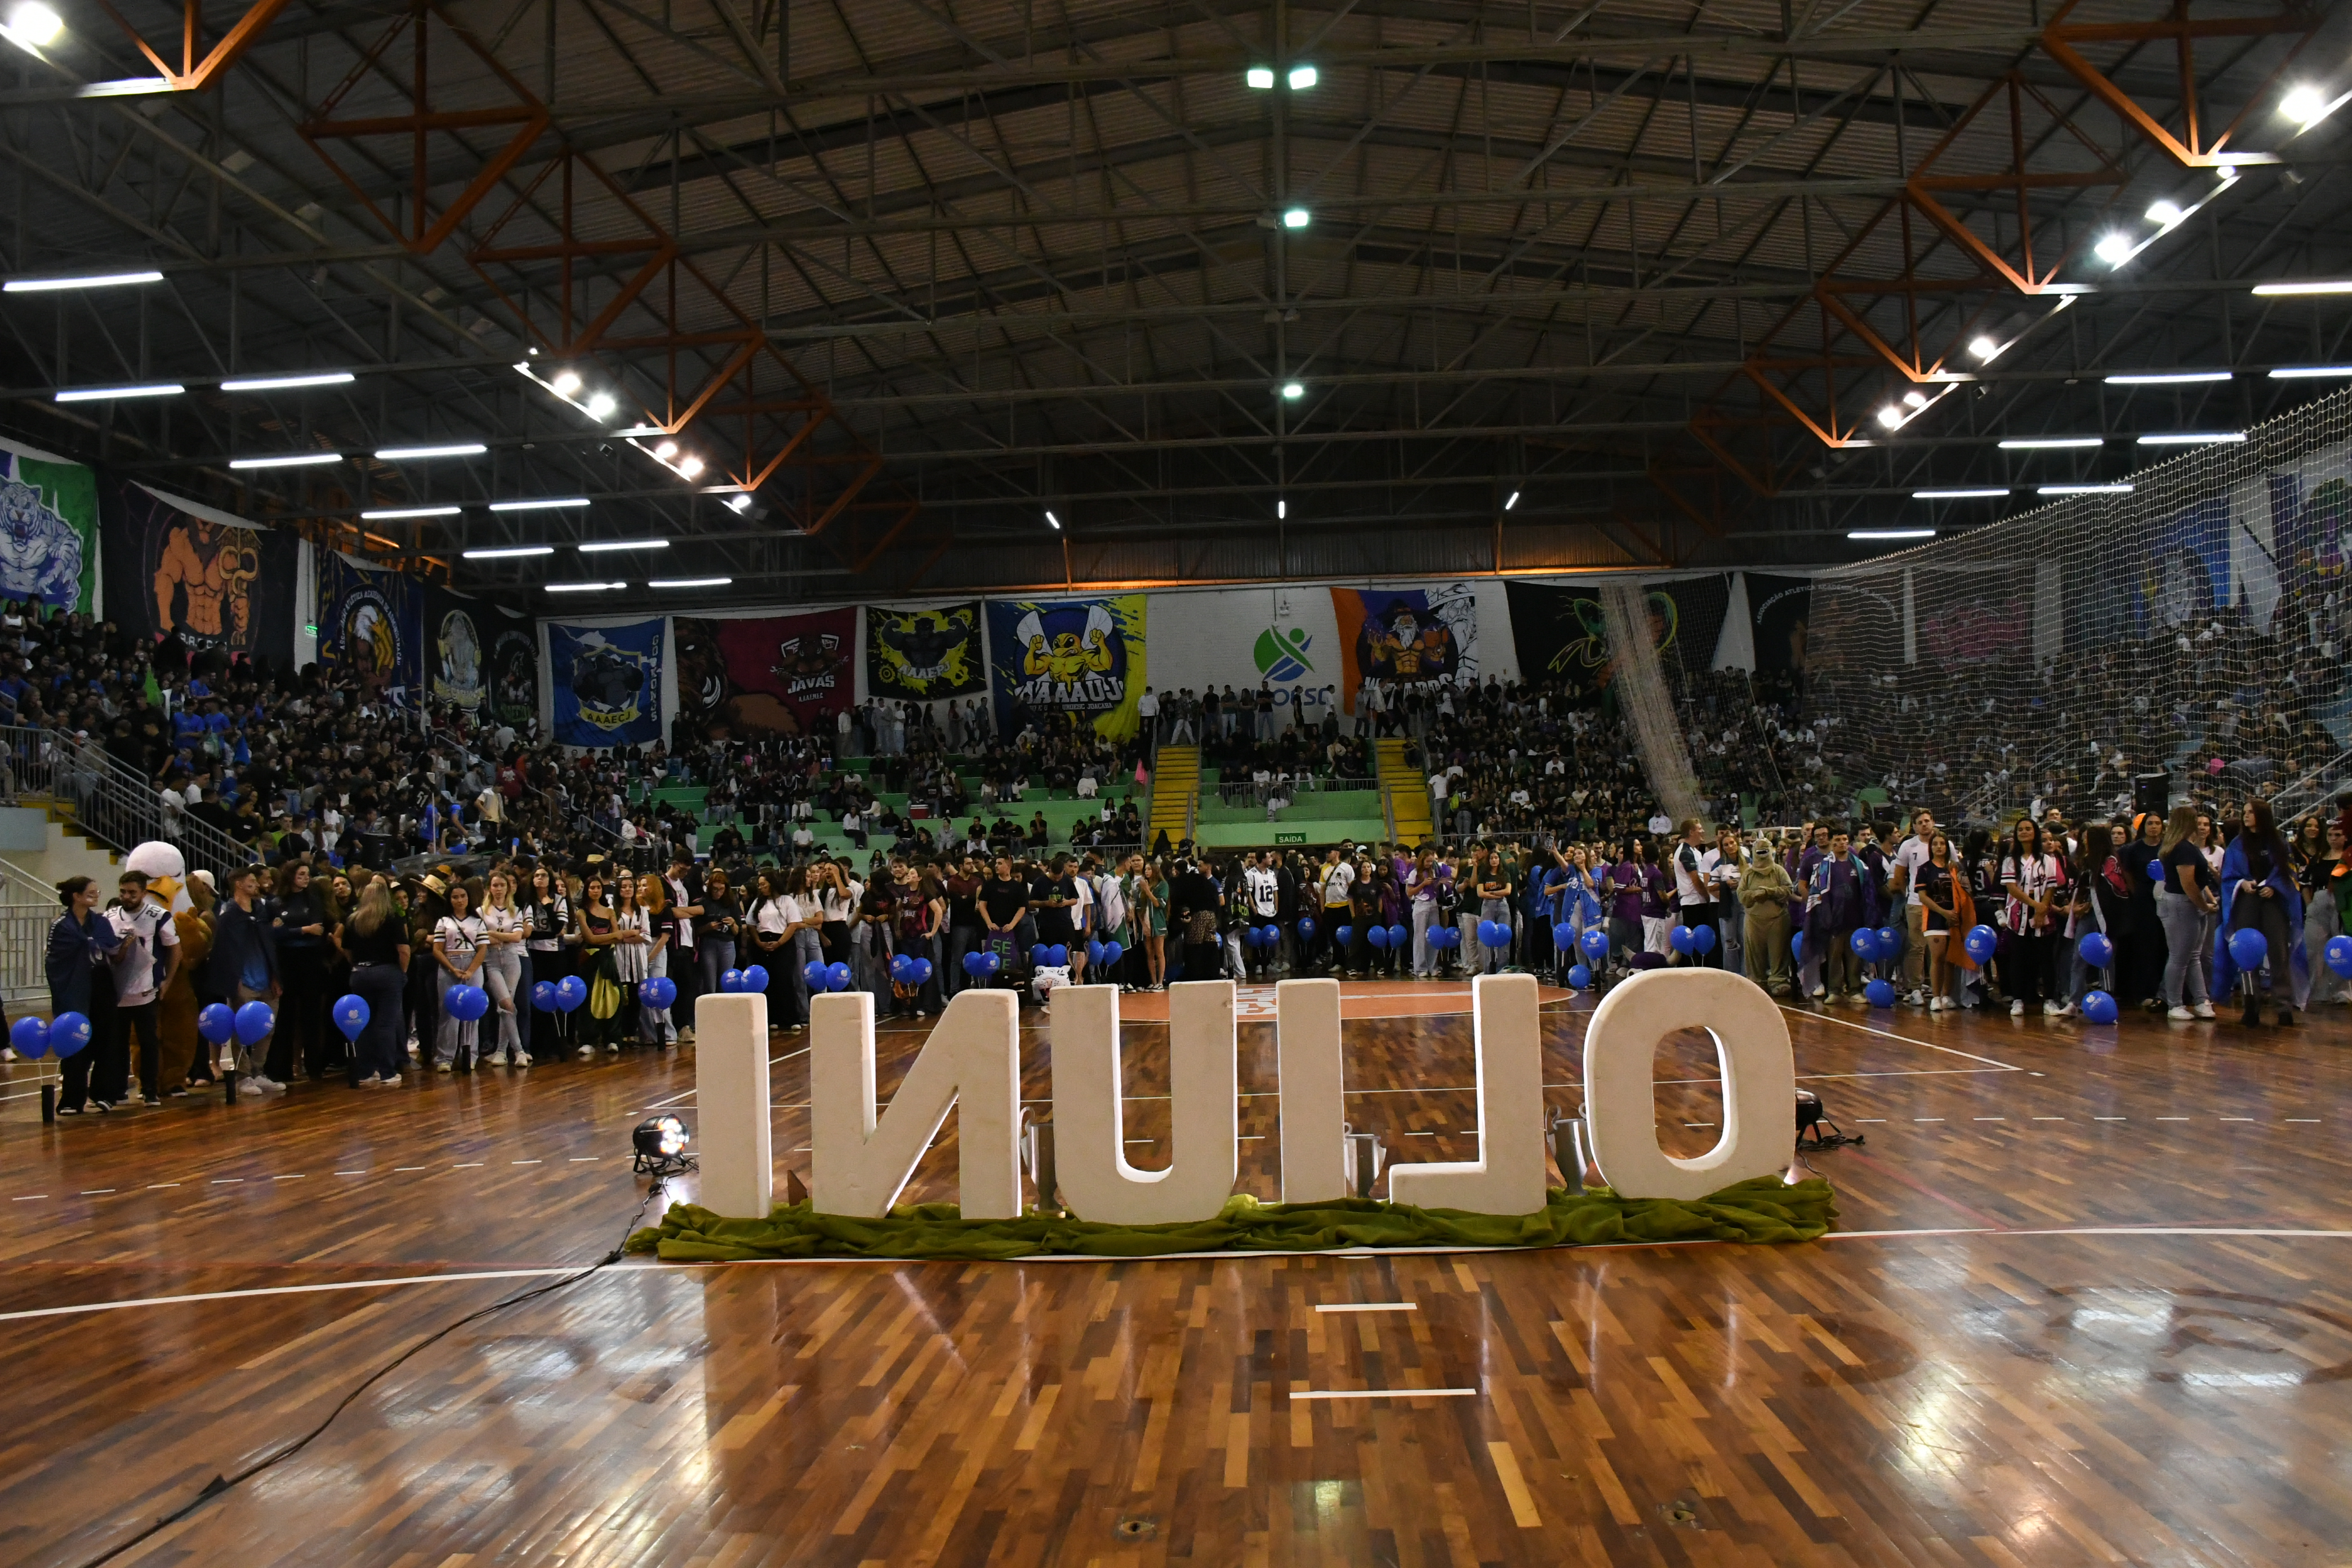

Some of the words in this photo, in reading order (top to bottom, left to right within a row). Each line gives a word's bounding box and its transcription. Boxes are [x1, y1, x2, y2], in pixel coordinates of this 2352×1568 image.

[1757, 591, 1783, 625] ASSOCIAÇÃO
[1785, 585, 1815, 596] ATLÉTICA
[787, 675, 835, 694] JAVAS
[587, 712, 630, 724] AAAECJ
[1259, 885, 1273, 902] 12
[146, 906, 161, 918] 20
[991, 938, 1012, 955] SÉ
